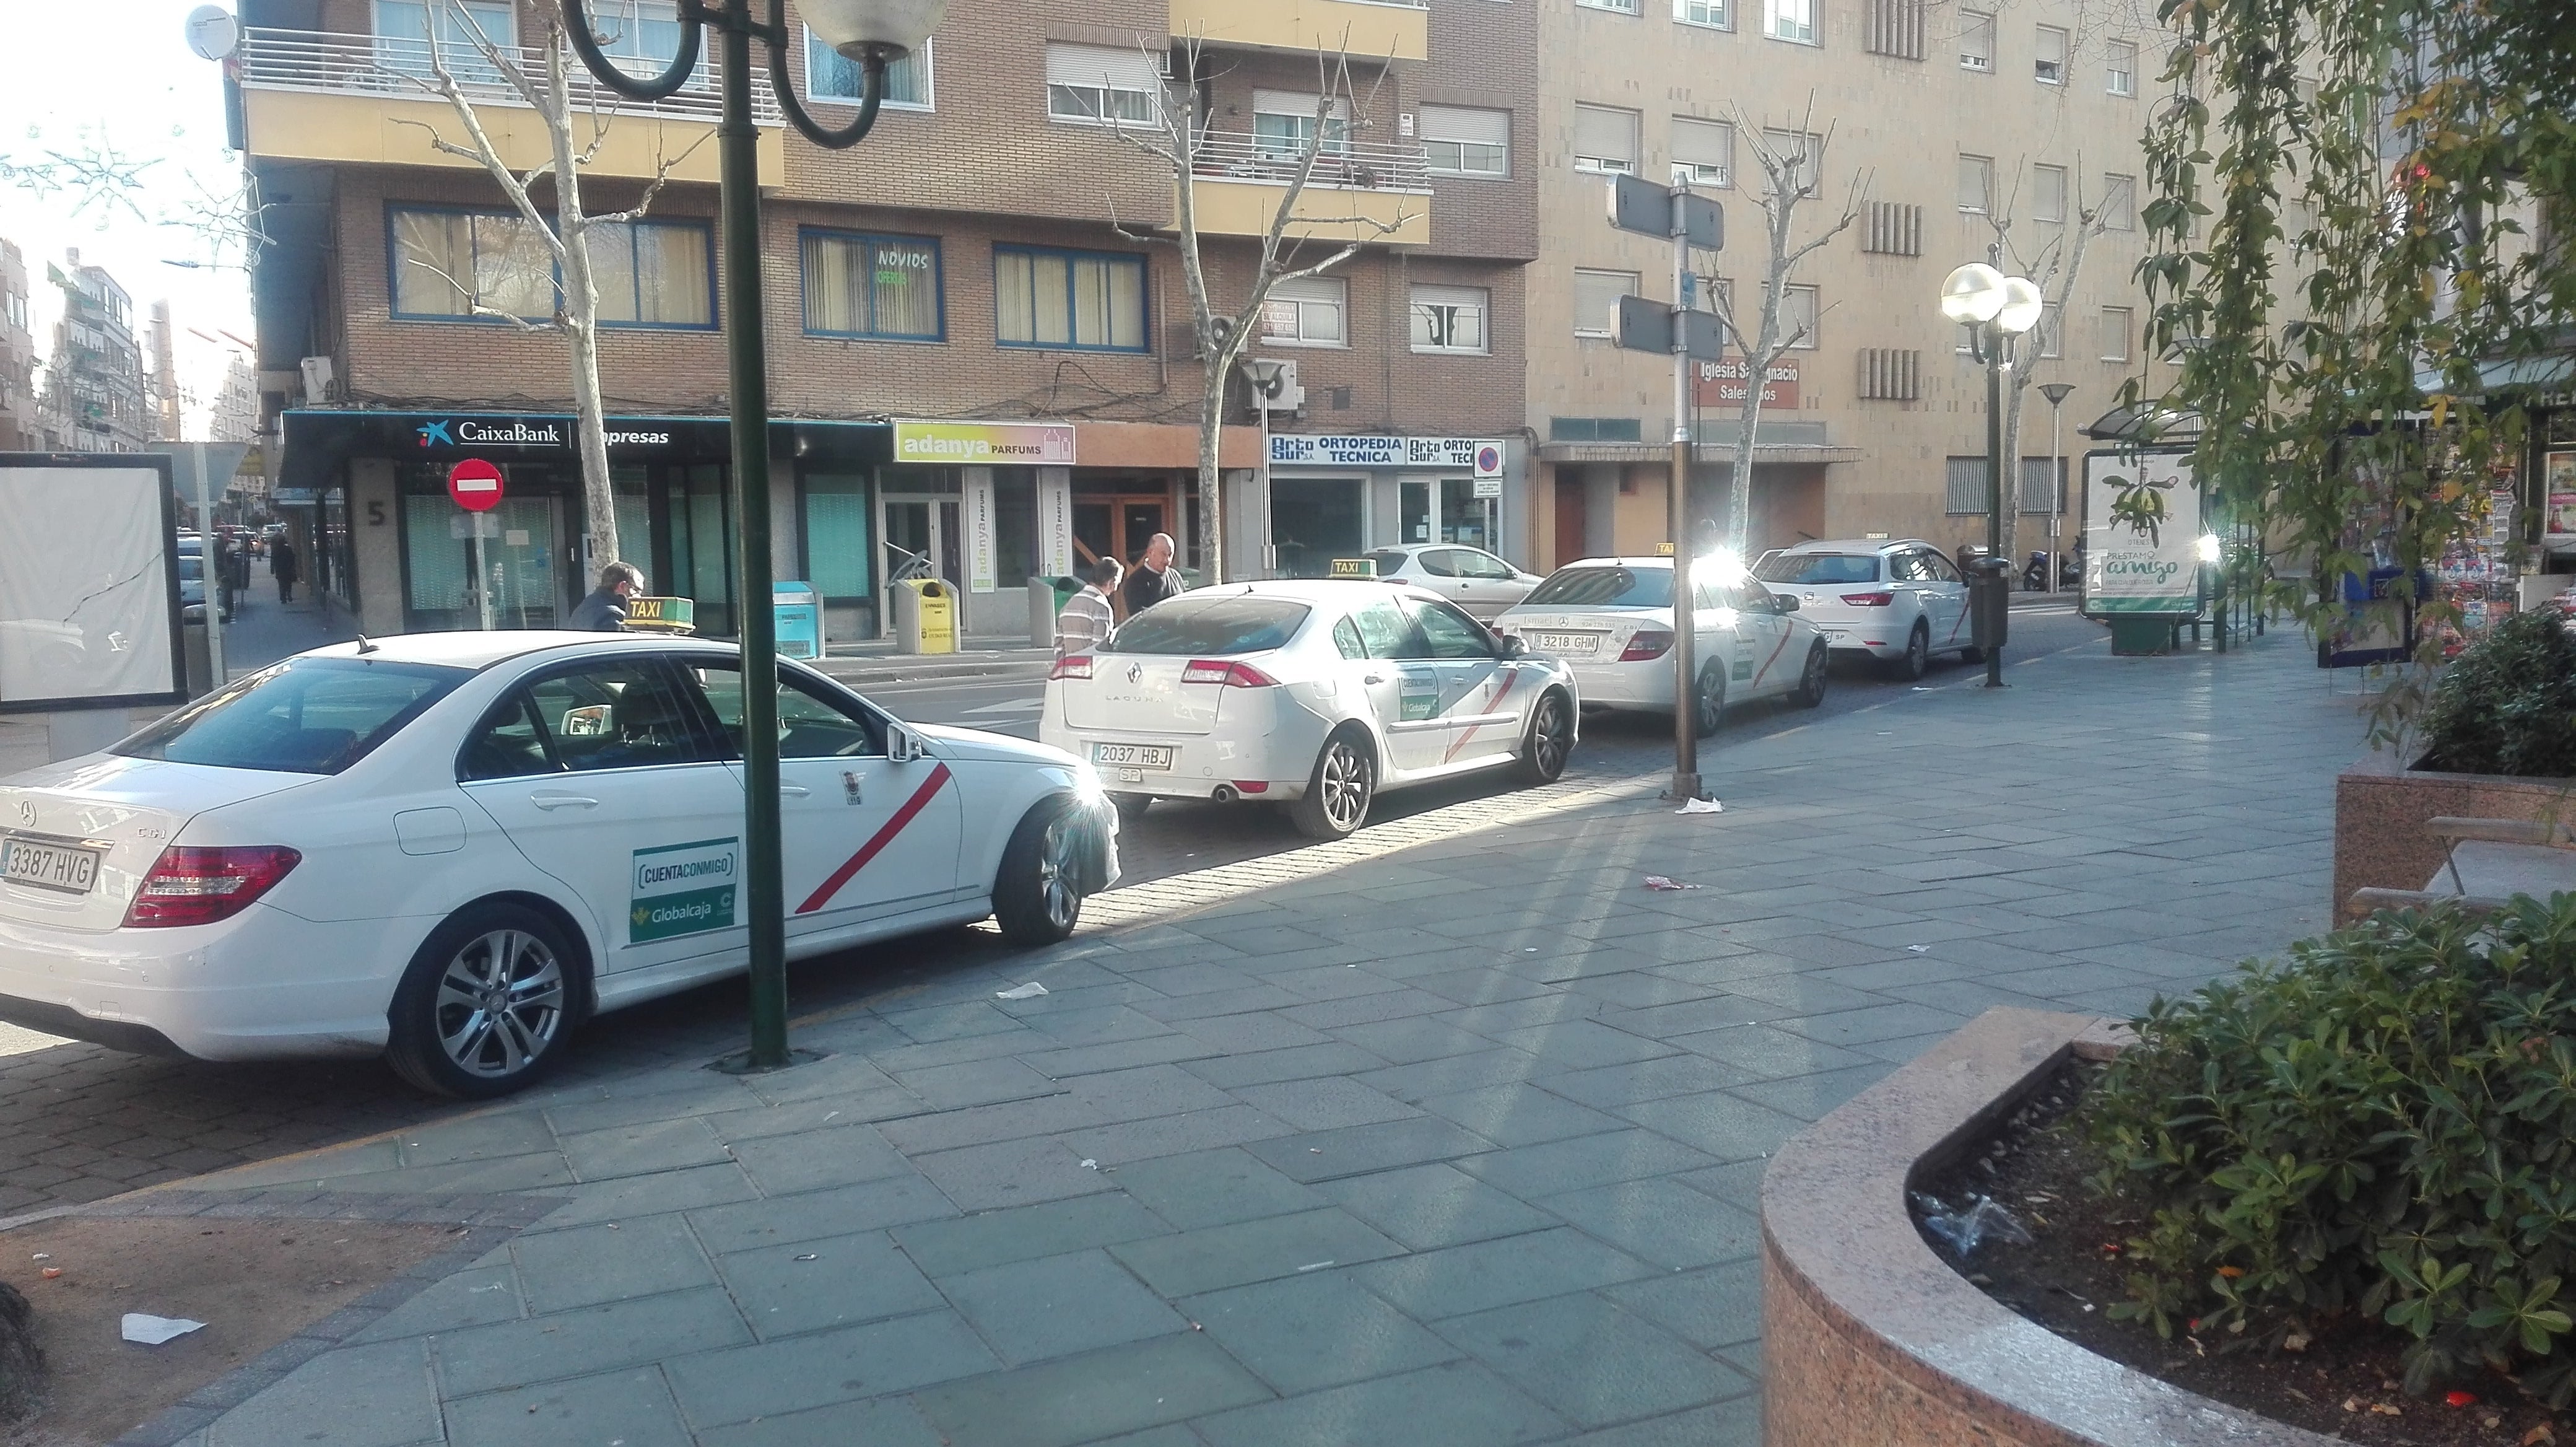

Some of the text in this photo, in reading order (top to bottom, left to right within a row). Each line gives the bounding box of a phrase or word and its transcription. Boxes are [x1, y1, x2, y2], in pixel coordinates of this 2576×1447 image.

[878, 250, 928, 269] NOVIOS
[1700, 362, 1736, 382] Iglesia
[1765, 364, 1798, 384] gnacio
[459, 422, 669, 447] CaixaBank presas
[1319, 437, 1403, 450] ORTOPEDIA
[904, 434, 1042, 458] adanya PARFUMS
[1443, 439, 1472, 450] ORTO
[1329, 451, 1392, 463] TECNICA
[1451, 453, 1473, 463] TEC
[368, 501, 385, 527] 5
[978, 522, 988, 574] adanya
[1055, 523, 1065, 574] adanya
[1334, 562, 1359, 573] TAXI
[2106, 561, 2178, 585] amigo
[630, 601, 661, 618] TAXI
[1544, 636, 1596, 649] 3218 GHM
[1100, 745, 1168, 765] 2037 HBJ
[1121, 769, 1139, 780] SP
[137, 827, 167, 839] CDI
[10, 847, 90, 884] 3387 HVG
[652, 901, 711, 923] Globalcaja
